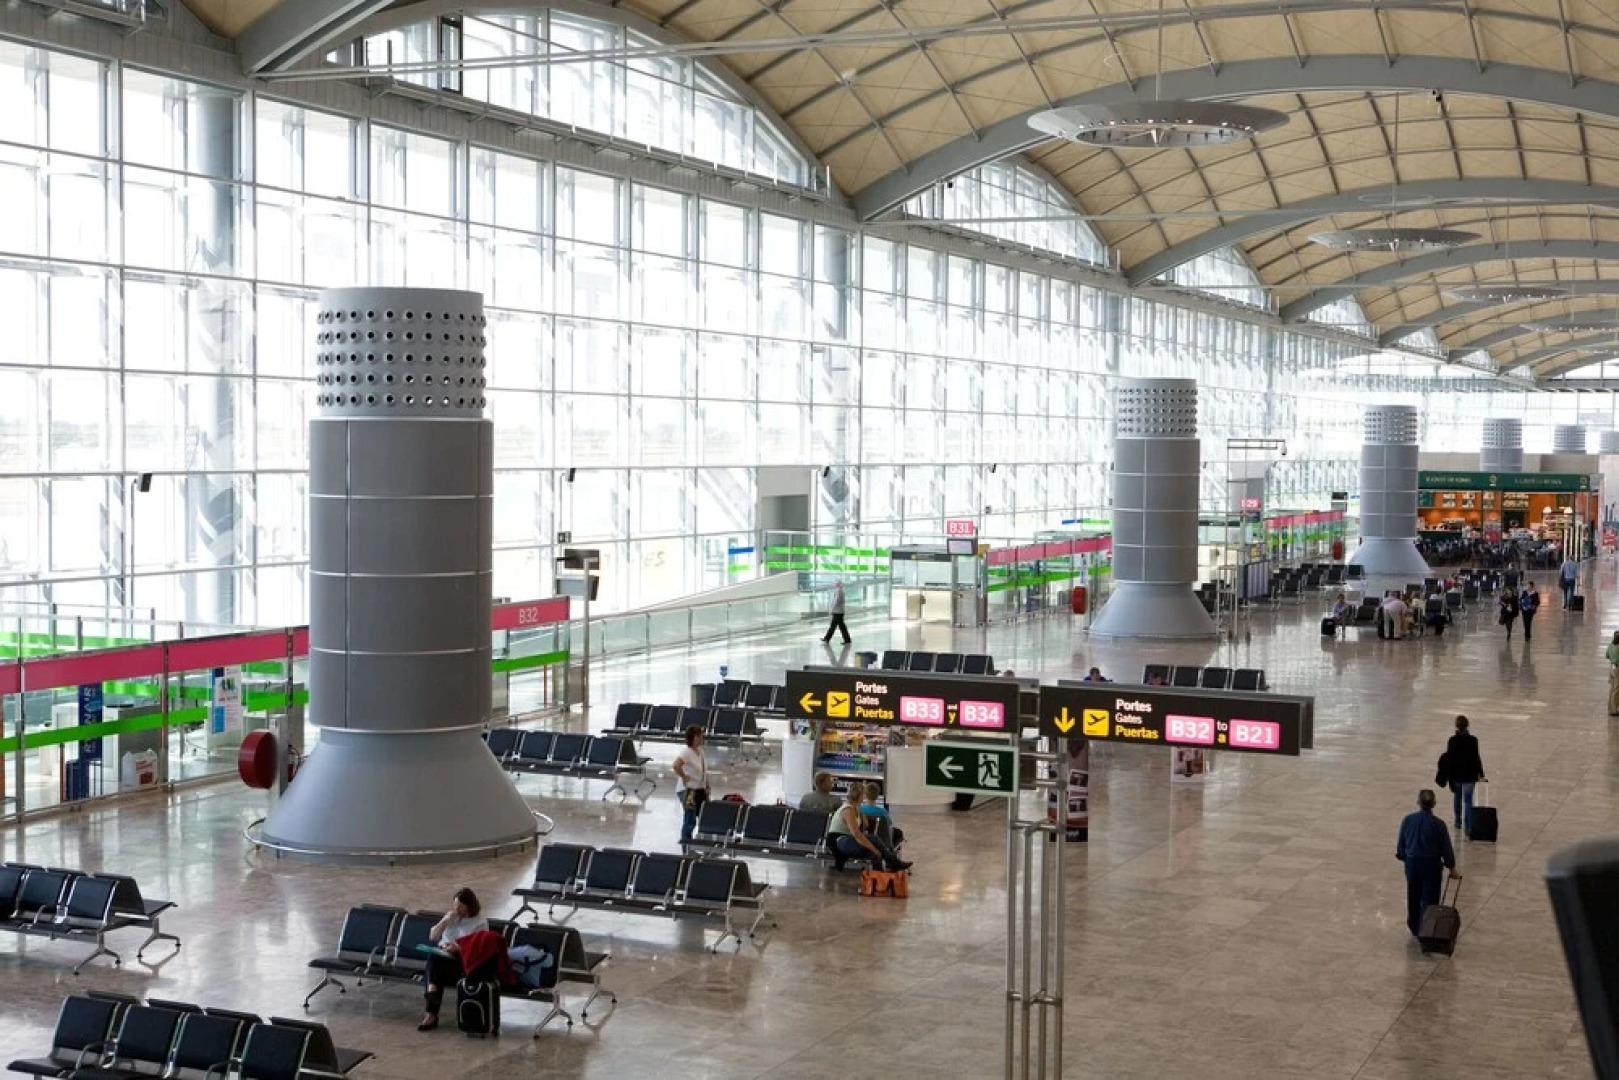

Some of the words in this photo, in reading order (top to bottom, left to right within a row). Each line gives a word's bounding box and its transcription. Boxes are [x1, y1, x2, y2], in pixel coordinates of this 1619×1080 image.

[949, 522, 968, 533] B31
[519, 606, 538, 624] B32
[855, 681, 888, 694] Portes
[855, 694, 879, 706] Gates
[1115, 699, 1152, 712] Portes
[855, 706, 894, 720] Puertas
[906, 701, 940, 719] B33
[964, 705, 999, 723] B34
[948, 712, 957, 724] y
[1115, 713, 1142, 725] Gates
[1115, 725, 1159, 739] Puertas
[1172, 720, 1209, 738] B32
[1217, 721, 1227, 731] to
[1236, 724, 1275, 744] B21
[1217, 733, 1226, 743] a
